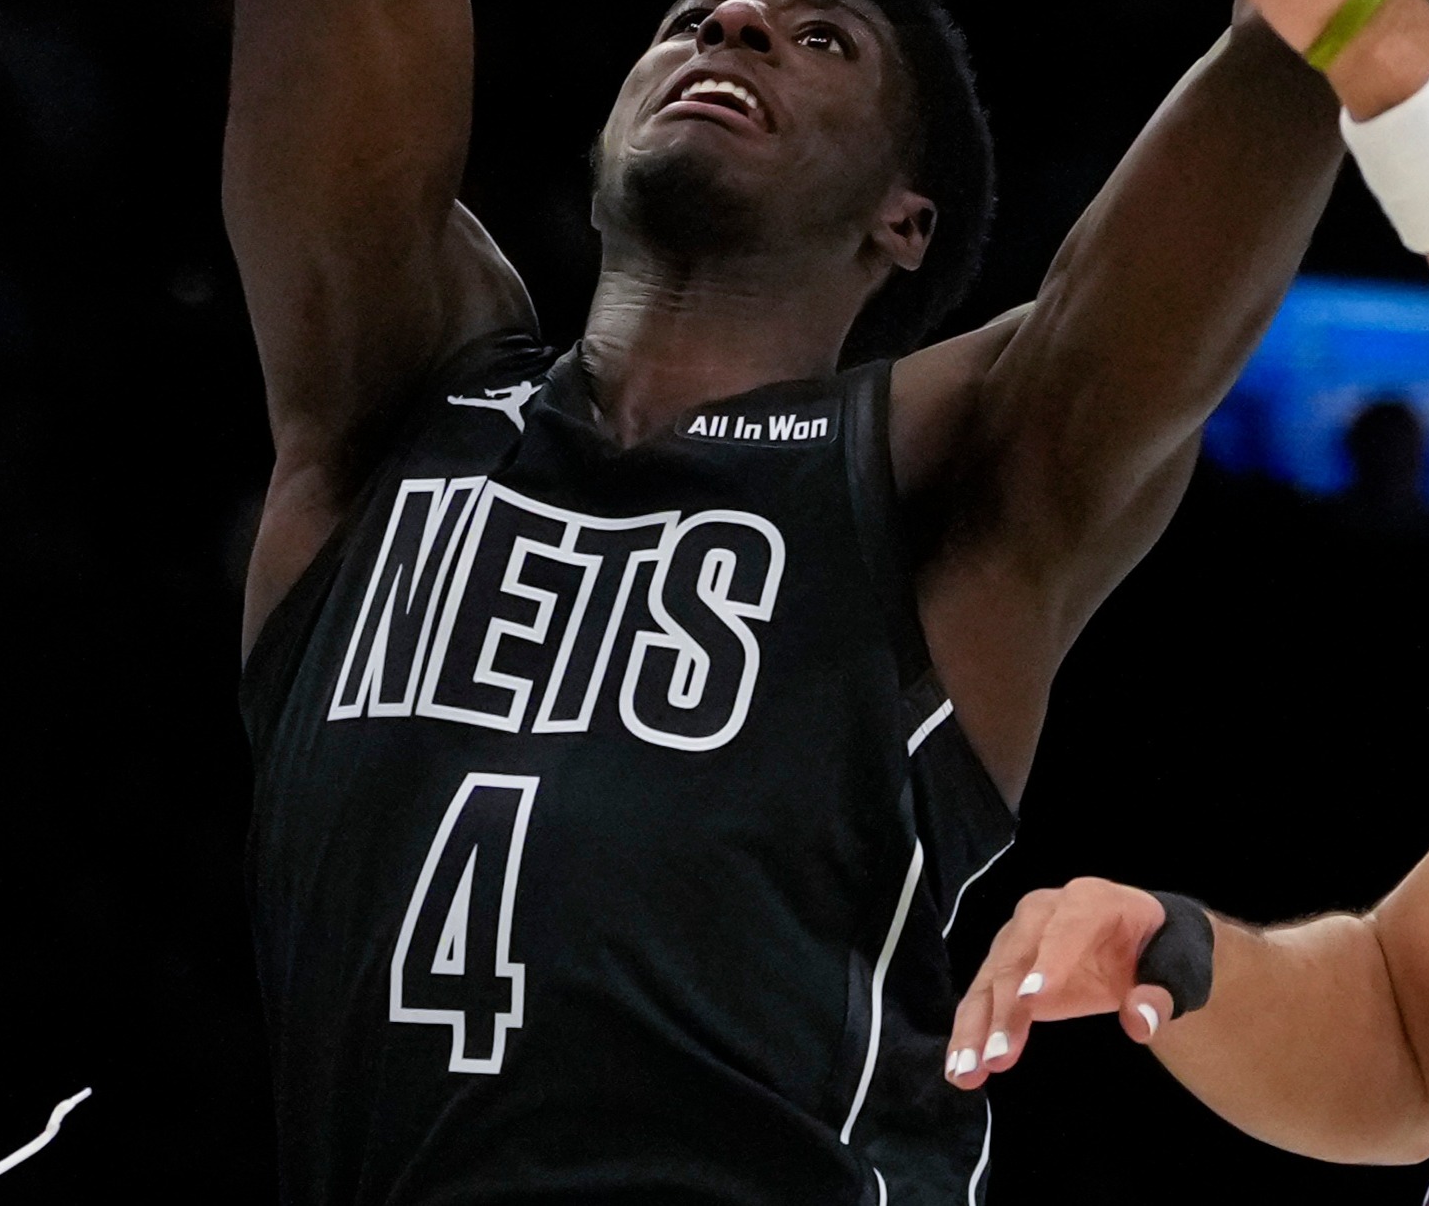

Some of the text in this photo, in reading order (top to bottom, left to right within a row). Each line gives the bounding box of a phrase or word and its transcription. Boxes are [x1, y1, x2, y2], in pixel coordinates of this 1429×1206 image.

[687, 414, 828, 441] All In Won
[327, 475, 786, 751] NETS
[389, 773, 540, 1074] 4
